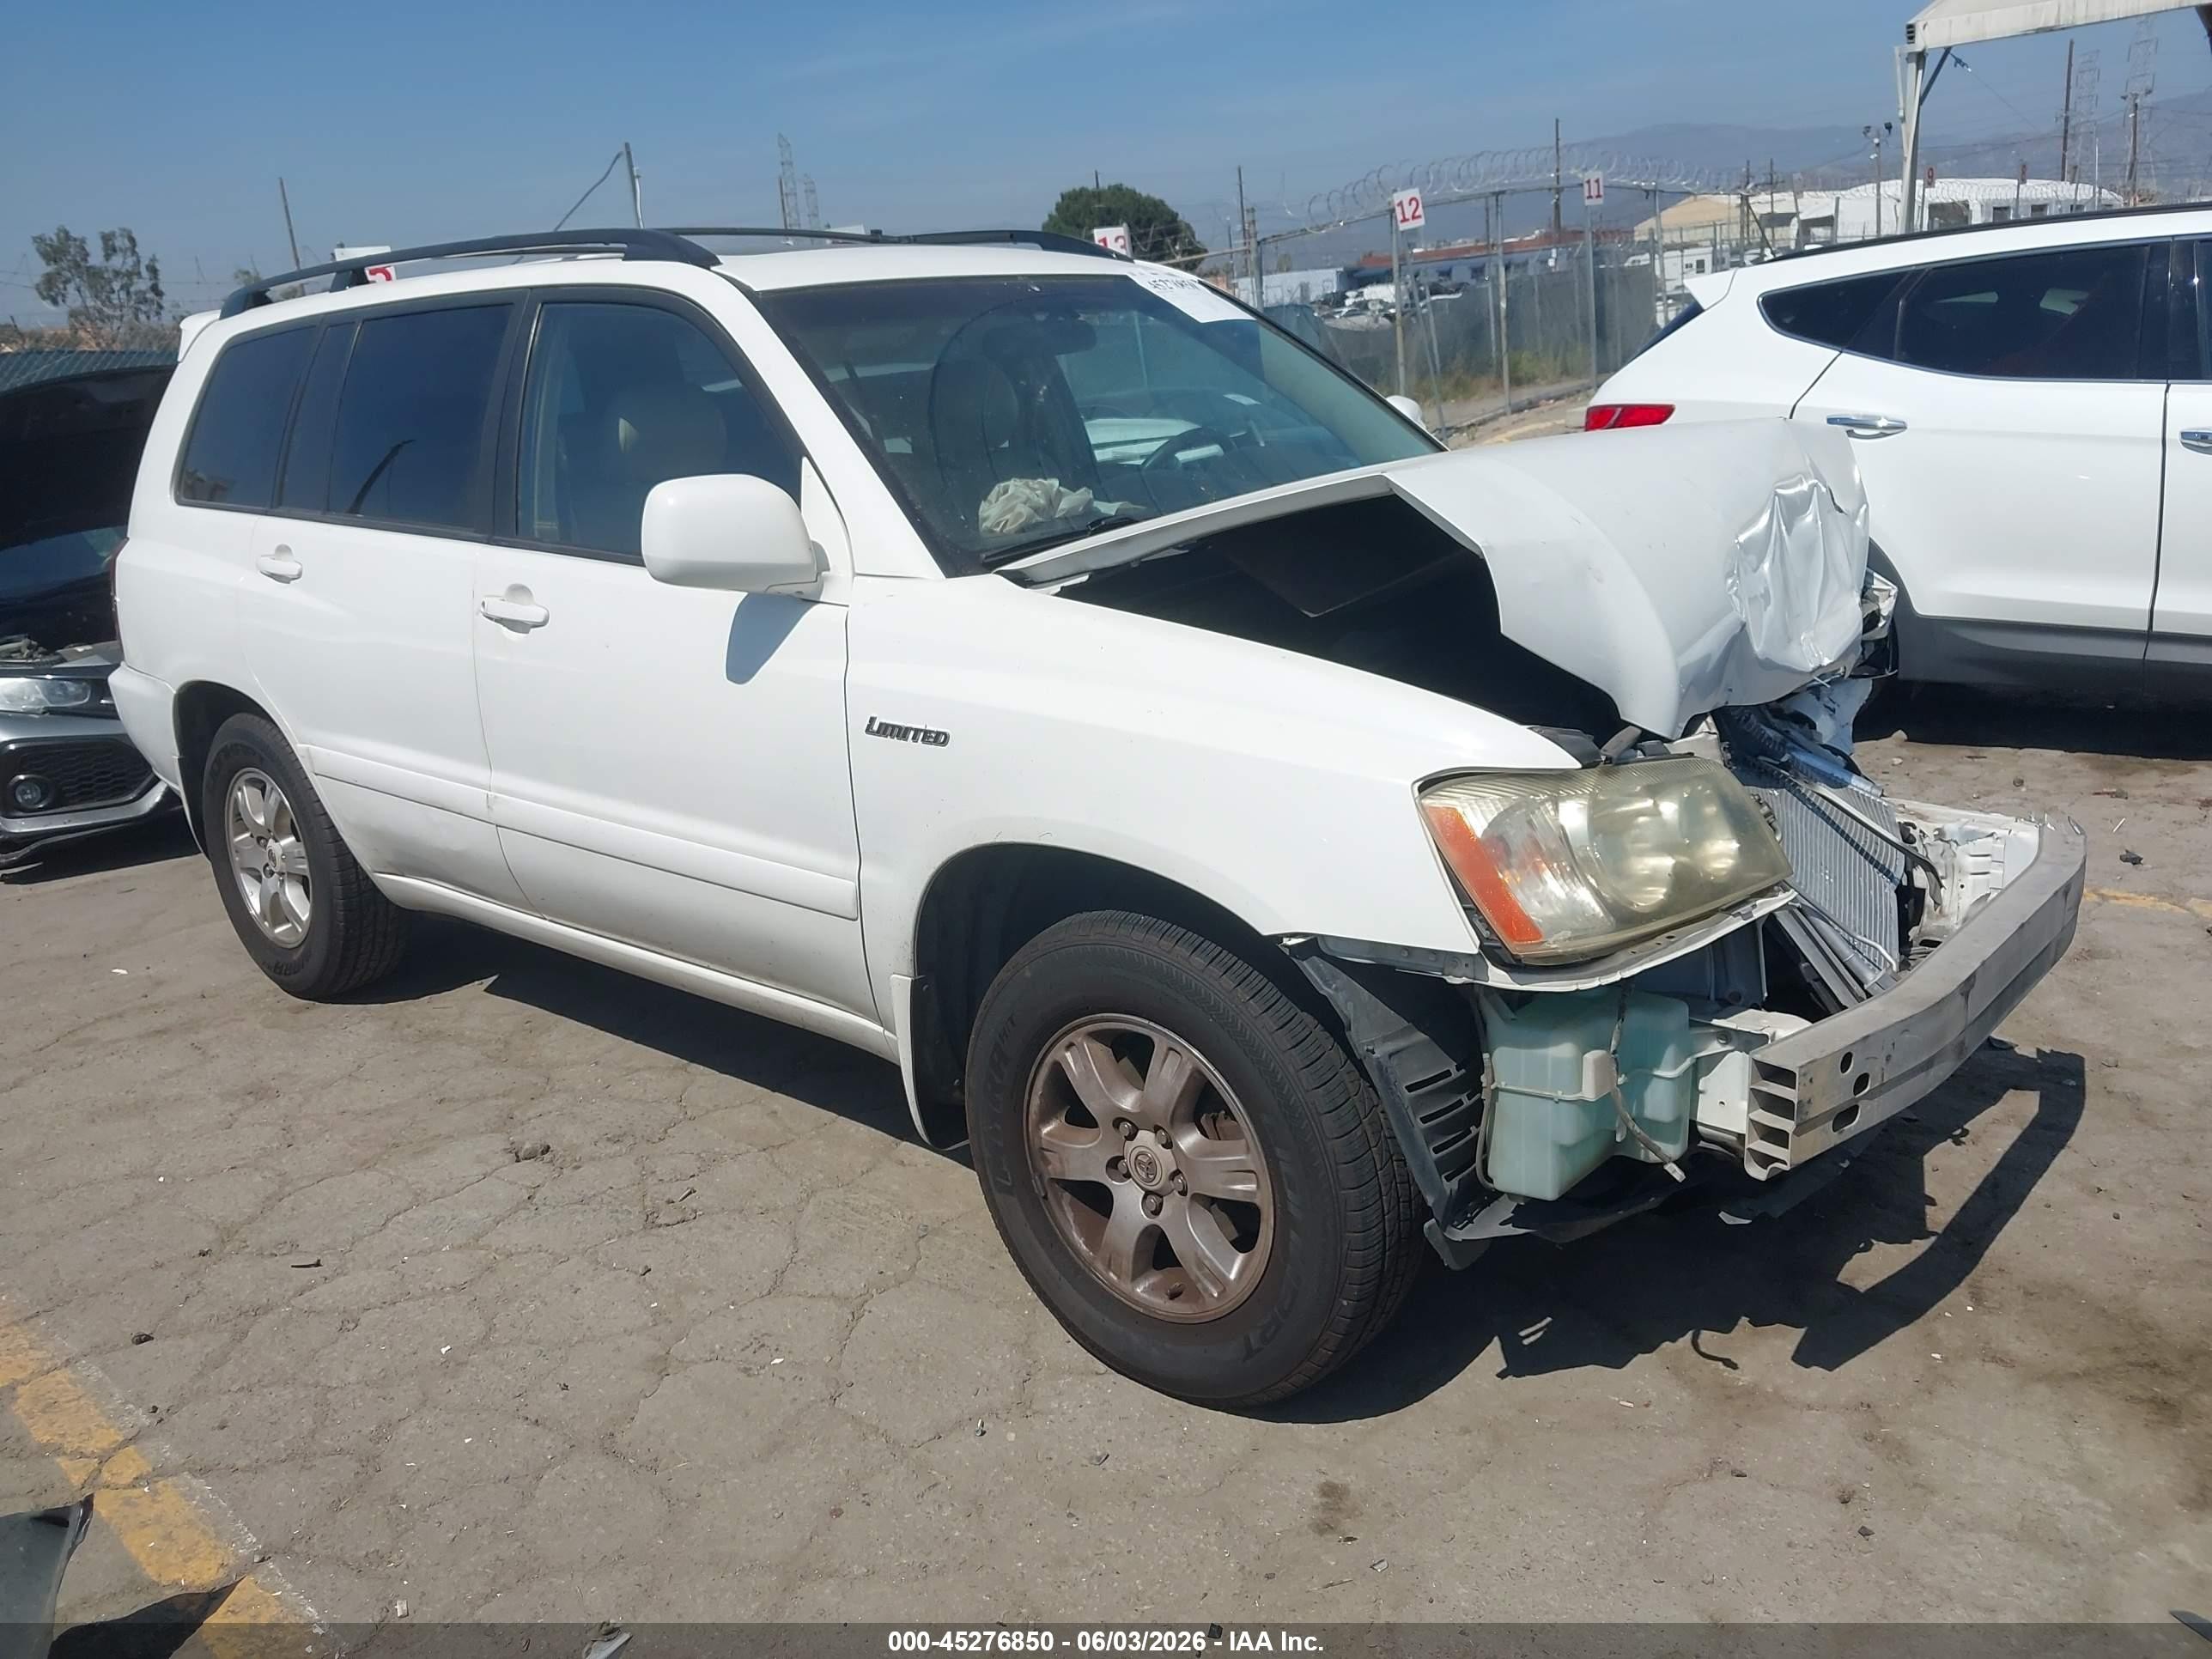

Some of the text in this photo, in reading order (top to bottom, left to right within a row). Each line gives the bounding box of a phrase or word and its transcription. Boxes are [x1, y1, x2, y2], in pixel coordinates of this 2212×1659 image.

[1927, 167, 1934, 185] 9
[1585, 178, 1603, 199] 11
[1396, 197, 1422, 223] 12
[865, 716, 951, 747] LIMITED
